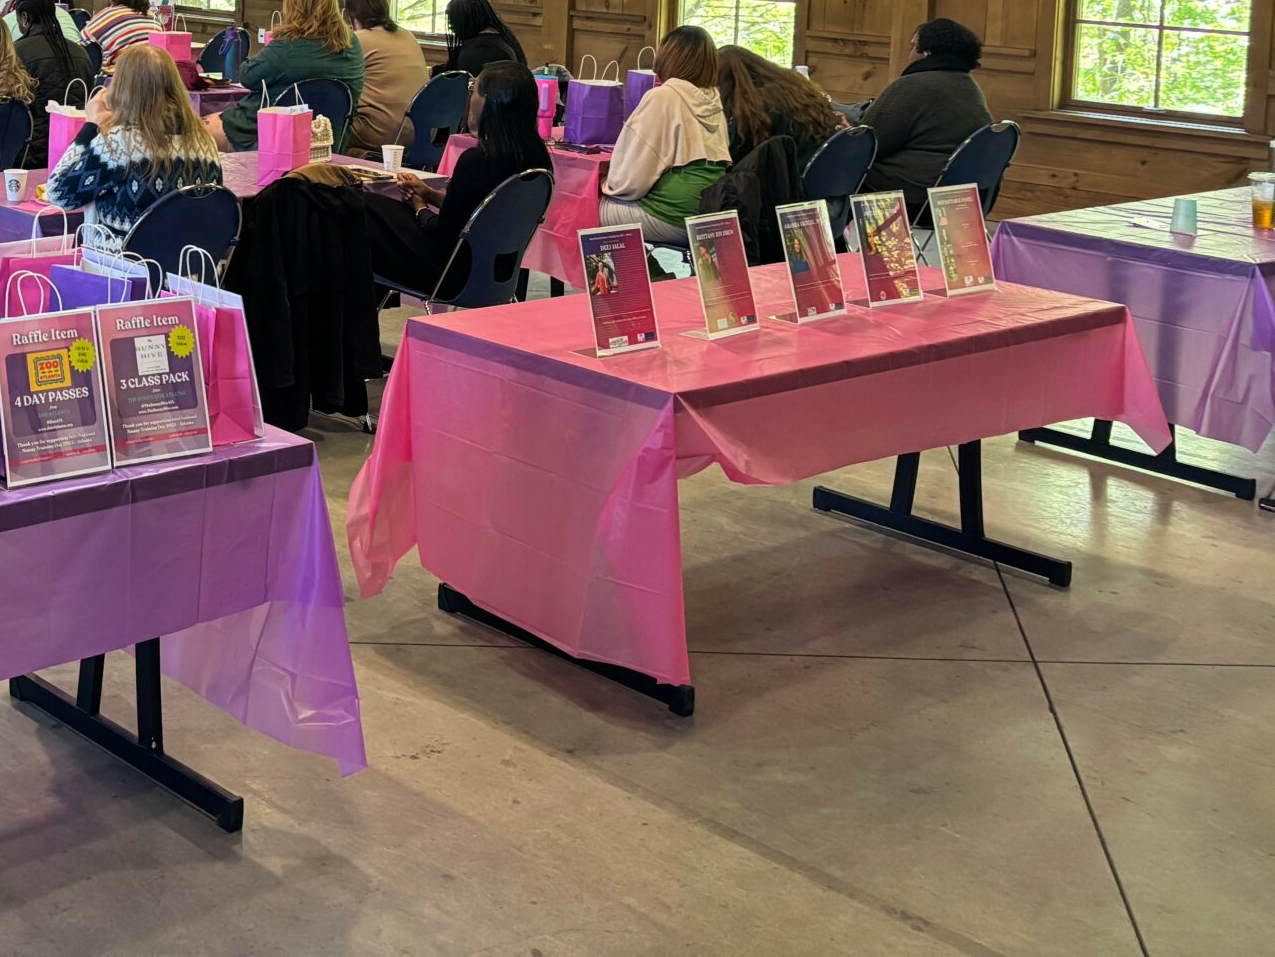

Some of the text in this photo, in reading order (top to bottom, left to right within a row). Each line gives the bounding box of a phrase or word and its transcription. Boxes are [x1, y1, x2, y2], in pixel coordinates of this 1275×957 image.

[115, 314, 180, 331] Raffle Item
[11, 328, 79, 346] Raffle Item
[135, 343, 167, 352] BUNNY
[140, 352, 163, 360] HIVE
[38, 360, 59, 371] ZOO
[119, 371, 191, 390] 3 CLASS PACK
[15, 386, 89, 408] 4 DAY PASSES
